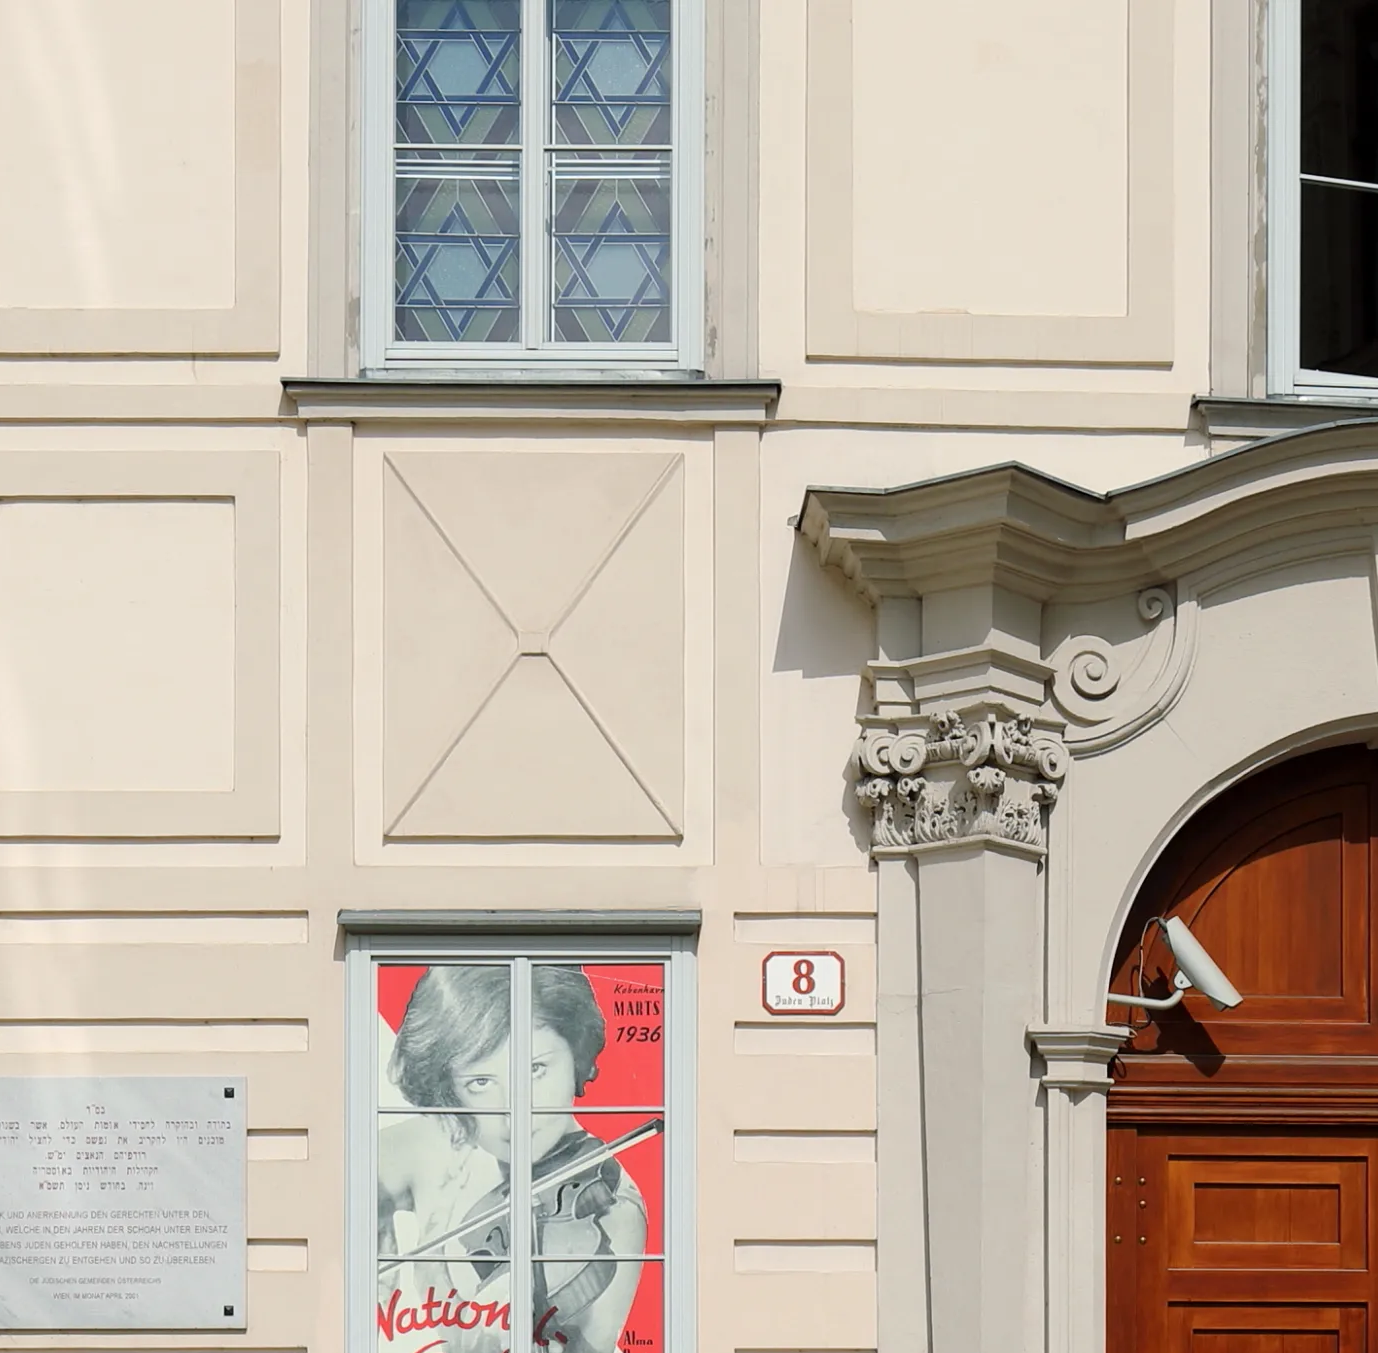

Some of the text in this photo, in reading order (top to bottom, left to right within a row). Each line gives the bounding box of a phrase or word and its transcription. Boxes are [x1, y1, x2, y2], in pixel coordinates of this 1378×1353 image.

[792, 959, 816, 994] 8
[774, 995, 803, 1006] Juden
[614, 1000, 660, 1016] MARTS
[616, 1025, 662, 1043] 1936
[31, 1121, 48, 1130] אשר
[117, 1136, 128, 1145] את
[6, 1210, 25, 1220] UND
[26, 1210, 88, 1220] ANERKENNUNG
[90, 1210, 108, 1220] DEN
[110, 1210, 160, 1220] GERECHTEN
[162, 1210, 190, 1220] UNTER
[192, 1210, 210, 1220] DEN
[5, 1225, 40, 1234] WELCHE
[42, 1225, 51, 1234] IN
[53, 1225, 71, 1234] DEN
[73, 1225, 105, 1234] JAHREN
[107, 1225, 125, 1234] DER
[127, 1225, 161, 1234] SCHOAH
[163, 1225, 192, 1234] UNTER
[194, 1225, 228, 1234] EINSATZ
[23, 1240, 52, 1250] JUDEN
[54, 1240, 98, 1250] GEHOLFEN
[100, 1240, 130, 1251] HABEN,
[132, 1240, 150, 1250] DEN
[152, 1240, 227, 1250] NACHSTELLUNGEN
[58, 1256, 70, 1265] ZU
[72, 1256, 117, 1265] ENTGEHEN
[119, 1256, 137, 1265] UND
[139, 1256, 151, 1265] SO
[153, 1256, 165, 1265] ZU
[81, 1292, 104, 1300] MONAT
[104, 1292, 123, 1300] APRIL
[623, 1330, 653, 1346] Alma
